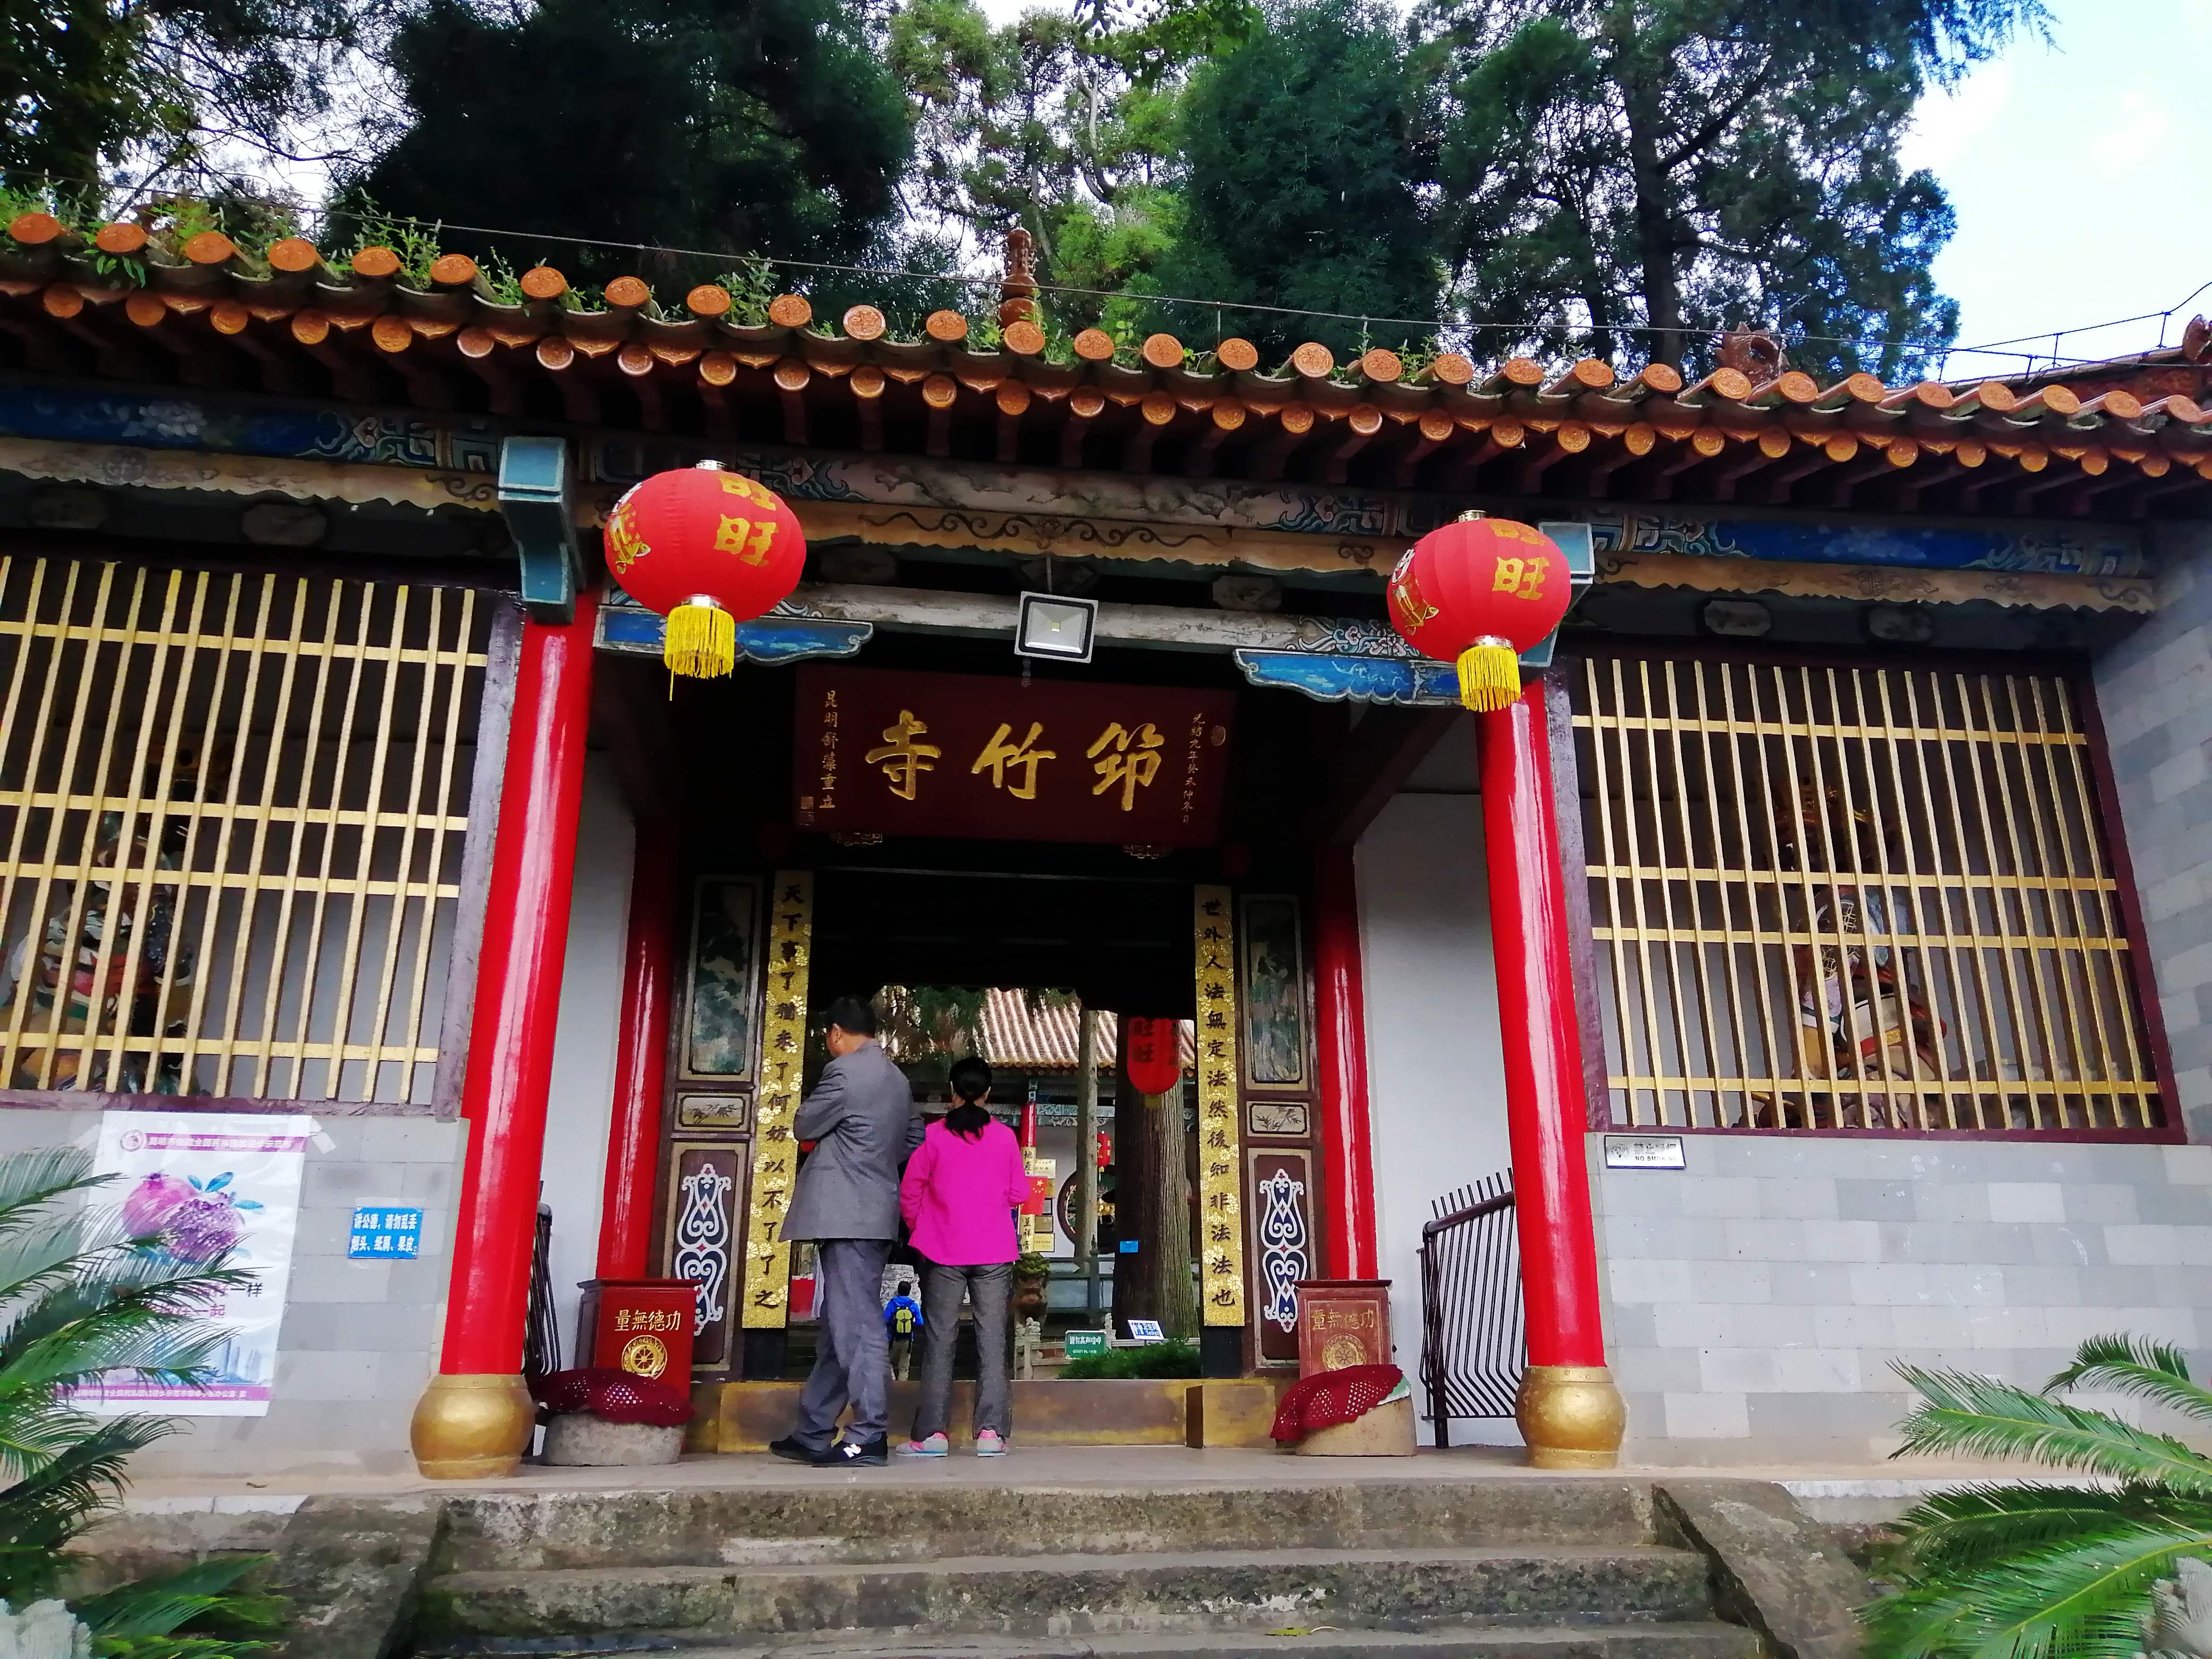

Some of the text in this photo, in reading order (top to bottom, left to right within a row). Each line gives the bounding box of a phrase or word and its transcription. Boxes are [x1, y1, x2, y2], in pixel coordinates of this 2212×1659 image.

[1202, 899, 1236, 1307] 世外人法無定法然後知非法法也
[614, 1309, 681, 1331] 功德無量
